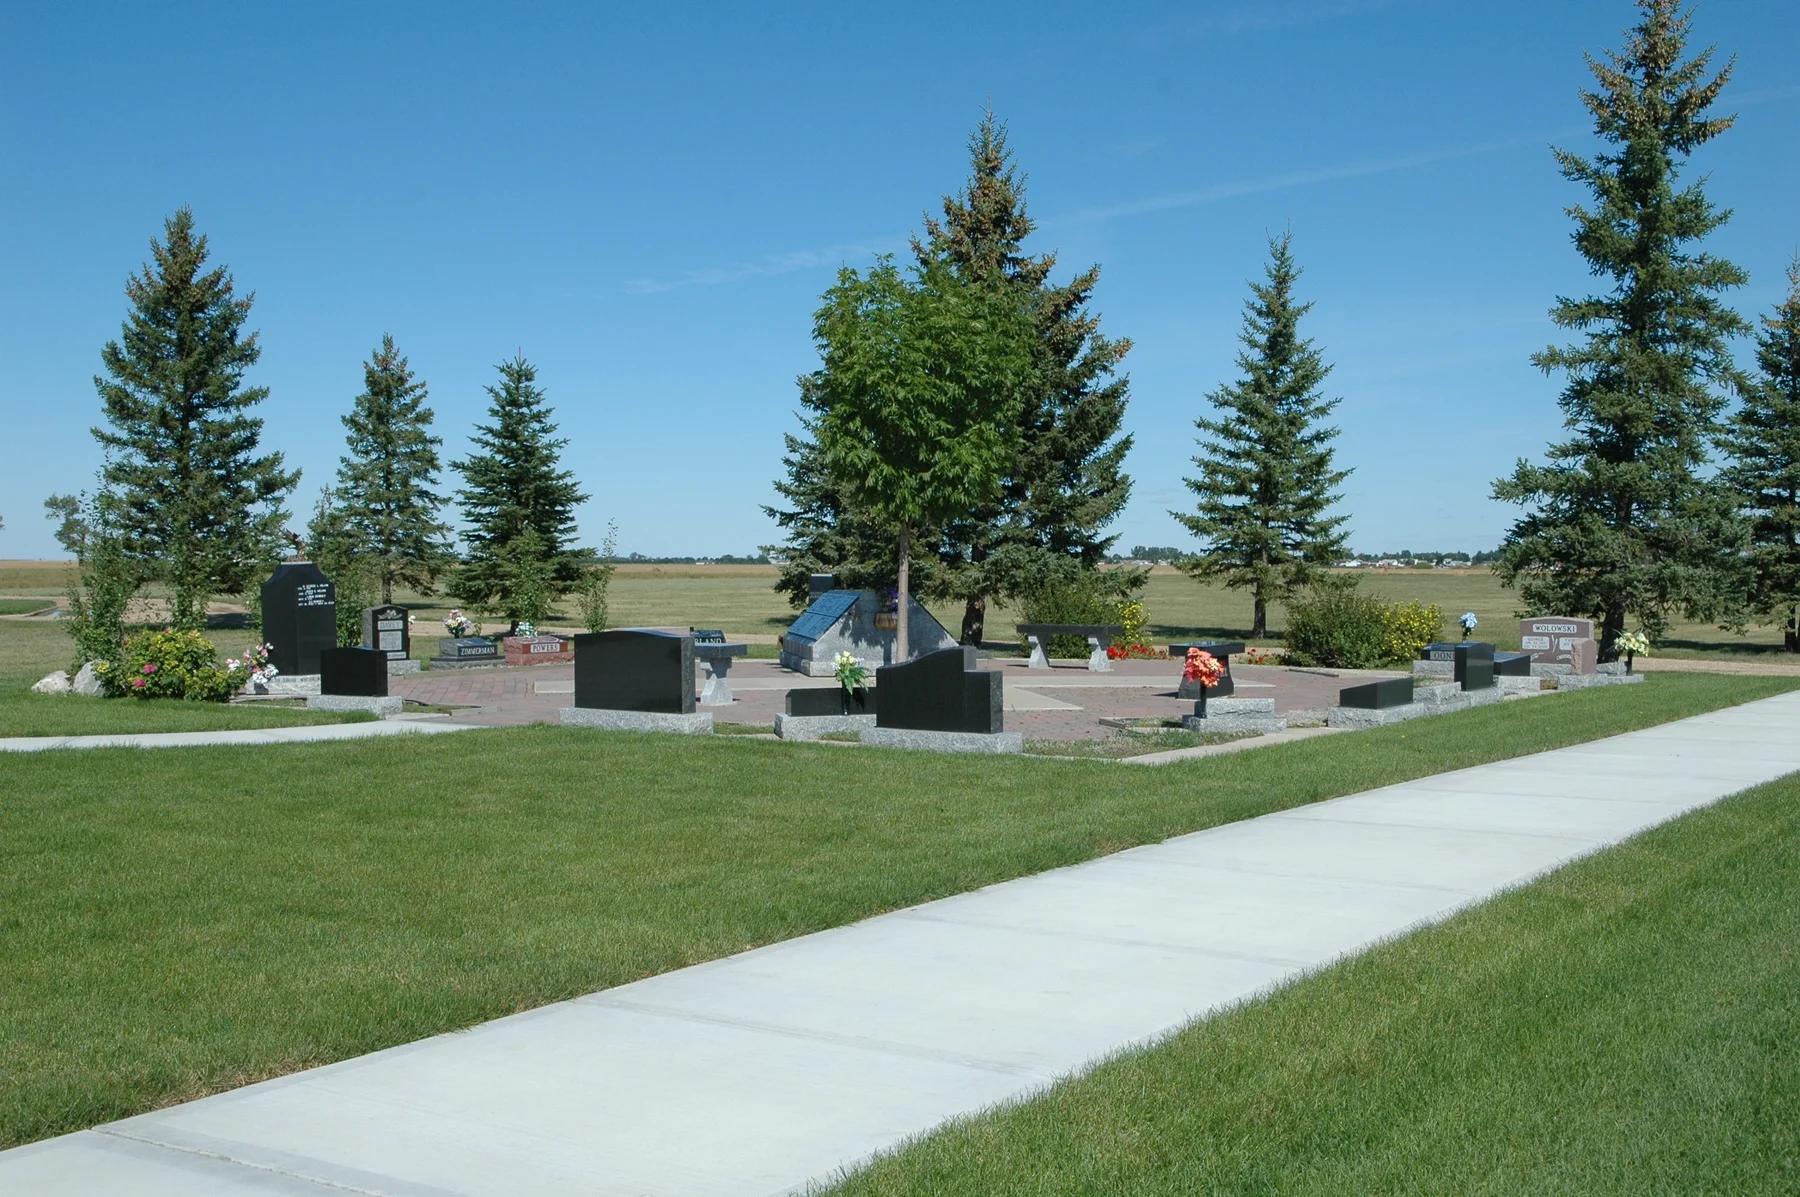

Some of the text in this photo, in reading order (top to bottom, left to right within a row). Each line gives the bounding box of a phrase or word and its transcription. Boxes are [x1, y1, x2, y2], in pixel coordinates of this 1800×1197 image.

[1534, 624, 1576, 632] WOLOWSKI
[460, 647, 495, 656] ZIMMERMAN
[532, 644, 558, 652] POWERS
